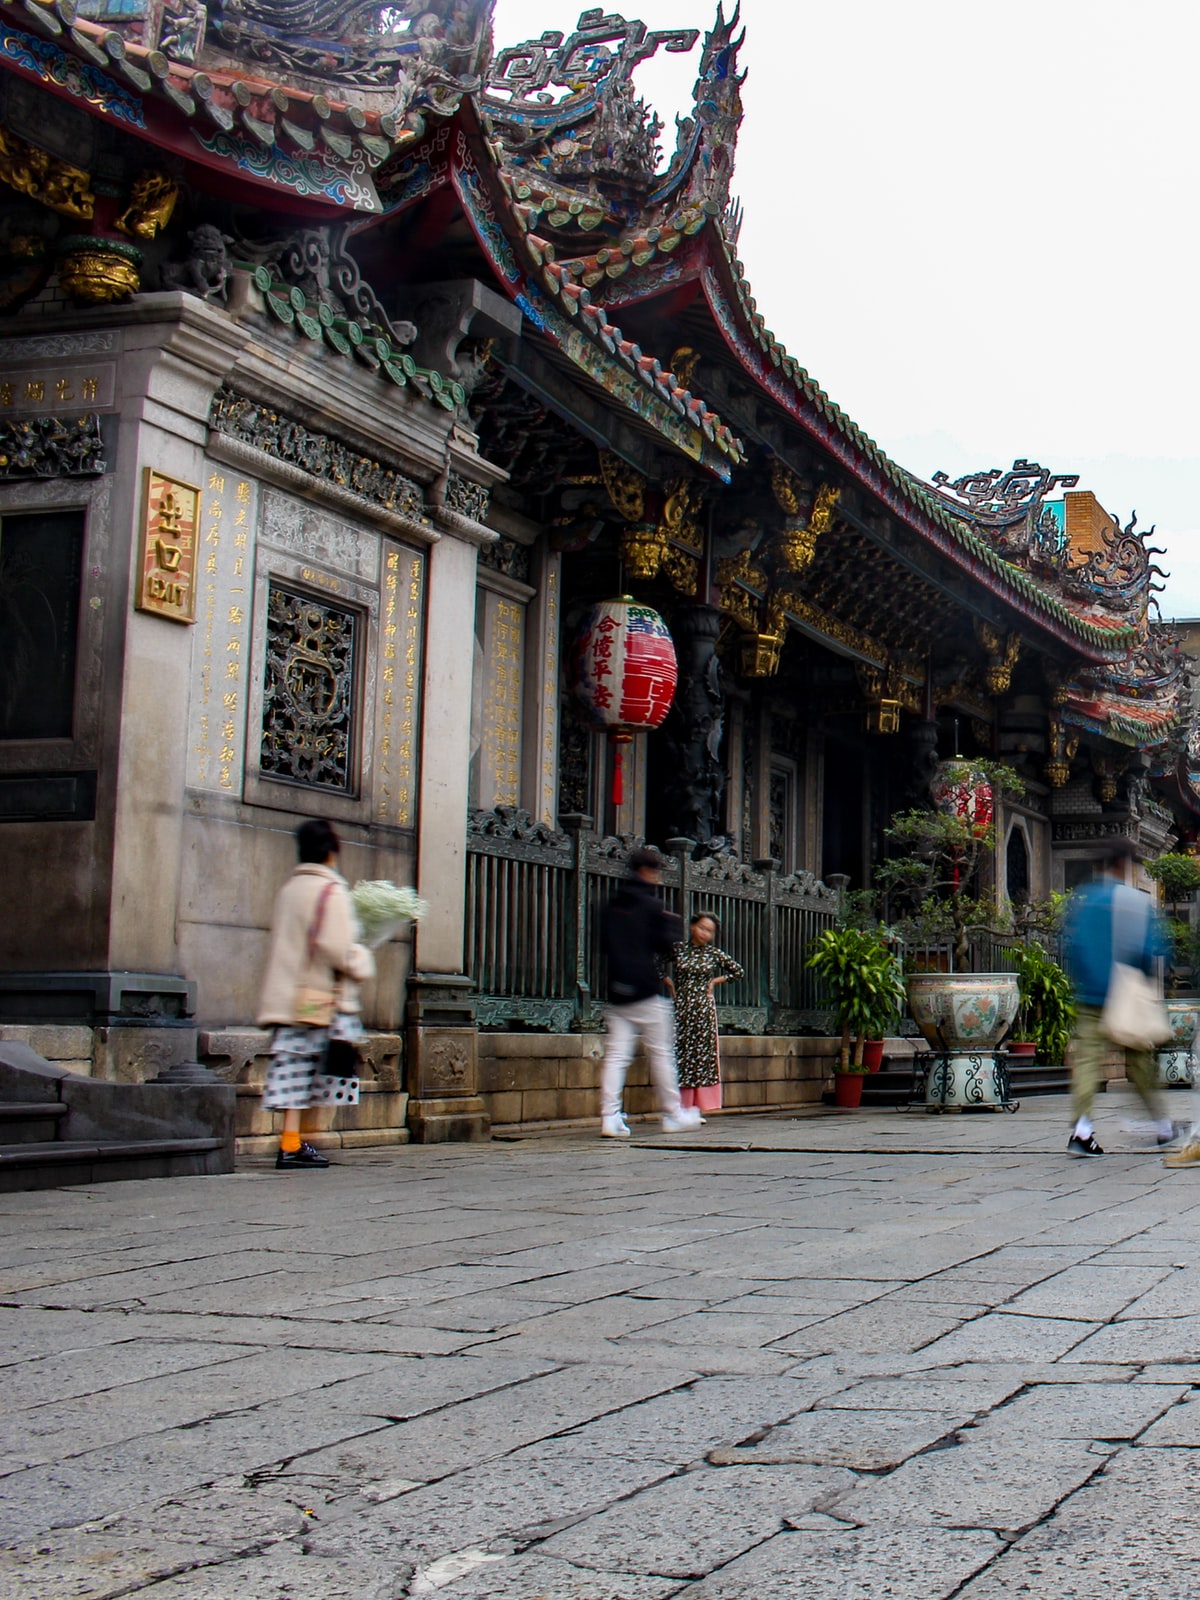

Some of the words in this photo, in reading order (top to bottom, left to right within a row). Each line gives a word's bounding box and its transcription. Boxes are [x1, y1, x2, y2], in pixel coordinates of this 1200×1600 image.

[156, 491, 183, 573] 出口
[148, 575, 187, 607] EXIT
[591, 615, 622, 709] 合境平安
